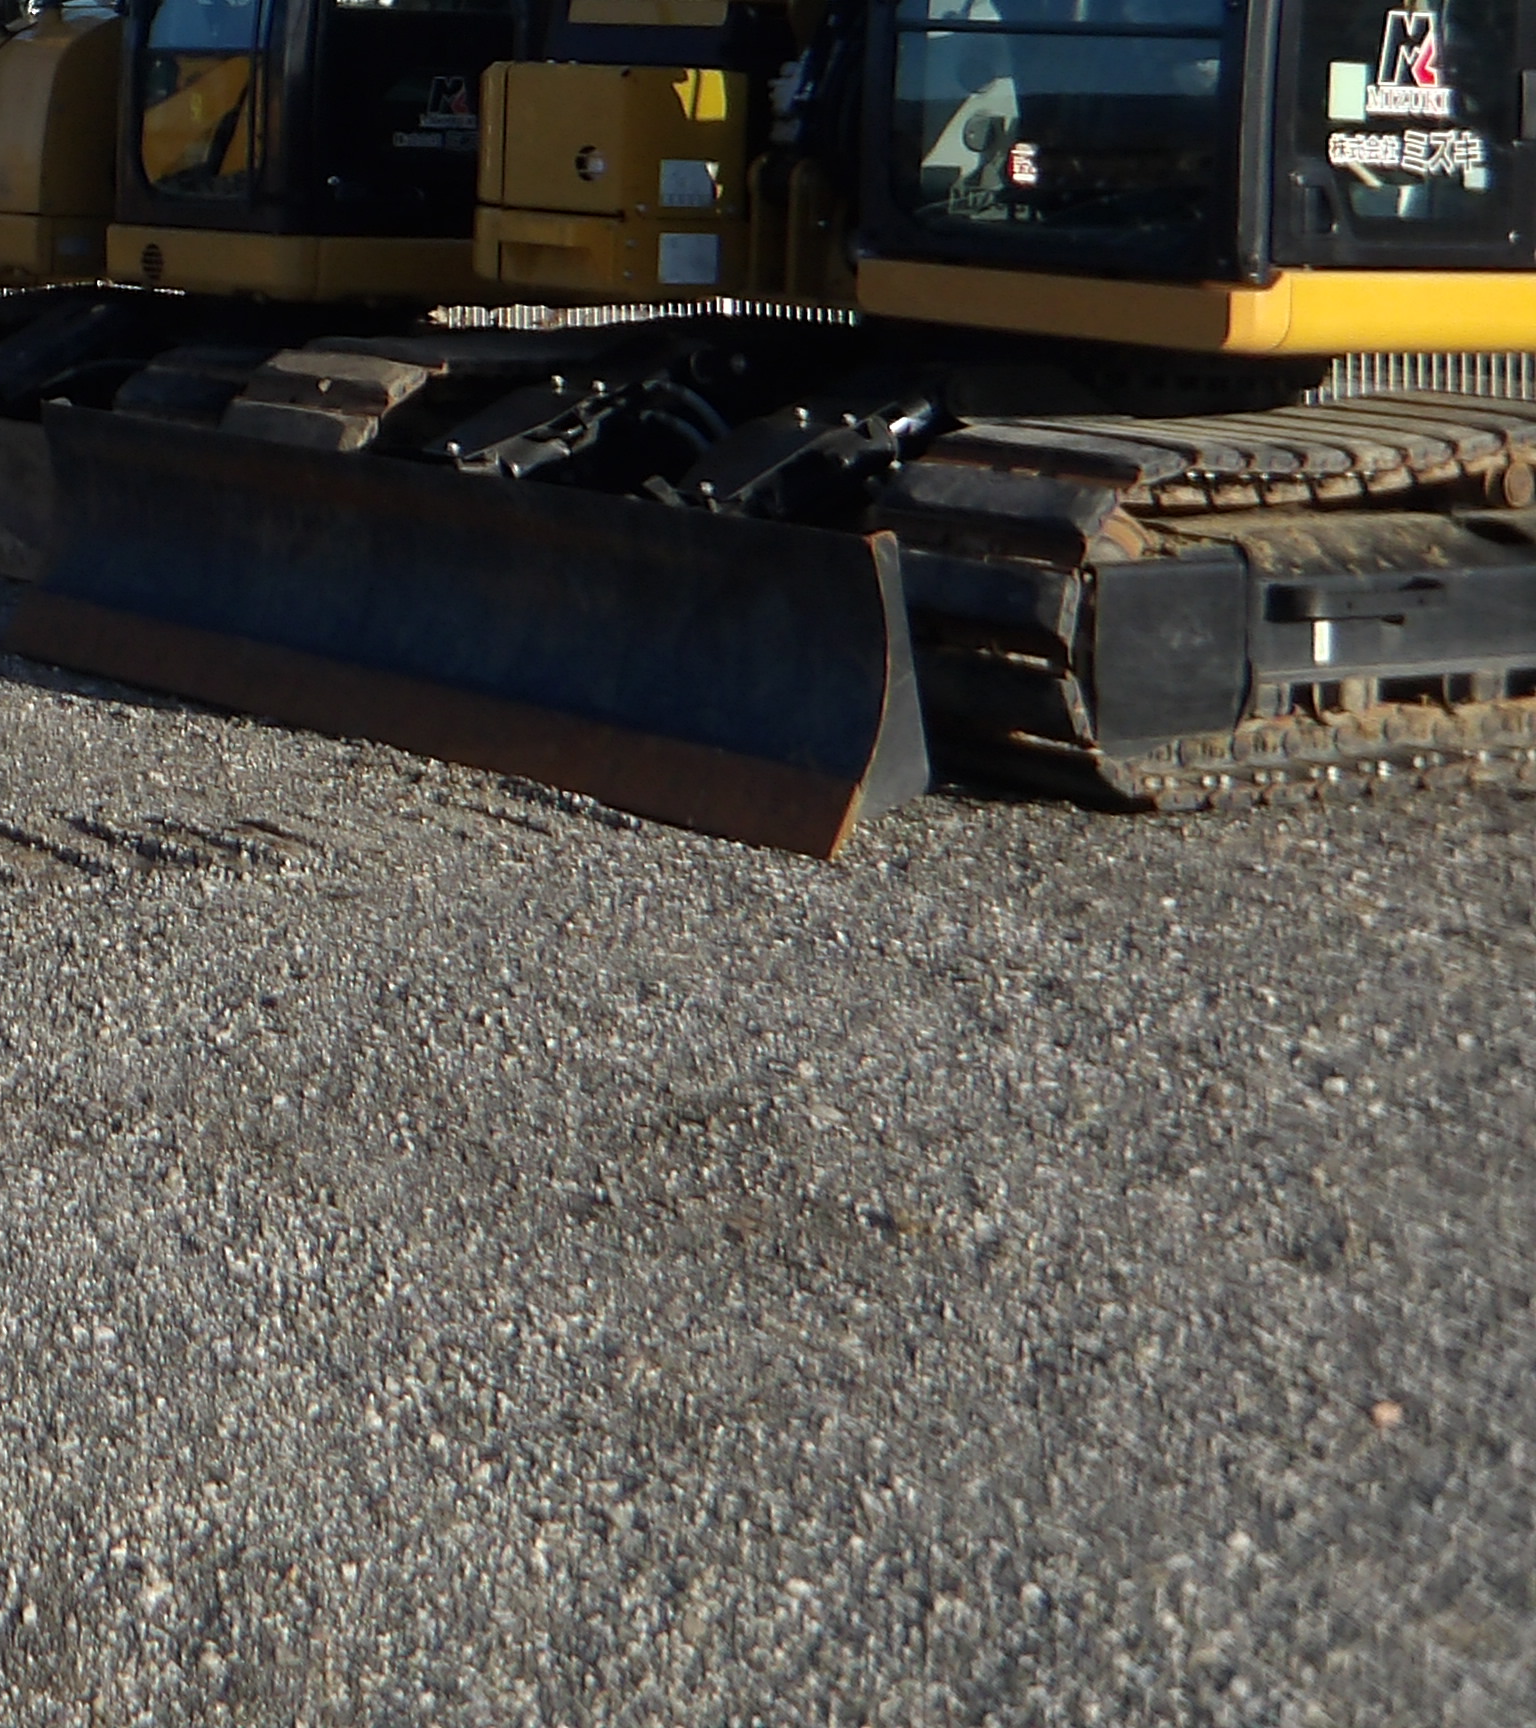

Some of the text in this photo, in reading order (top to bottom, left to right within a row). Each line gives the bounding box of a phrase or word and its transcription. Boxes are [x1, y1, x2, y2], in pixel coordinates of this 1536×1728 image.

[1366, 85, 1453, 116] MIZUKI
[1400, 128, 1485, 177] ミズキ
